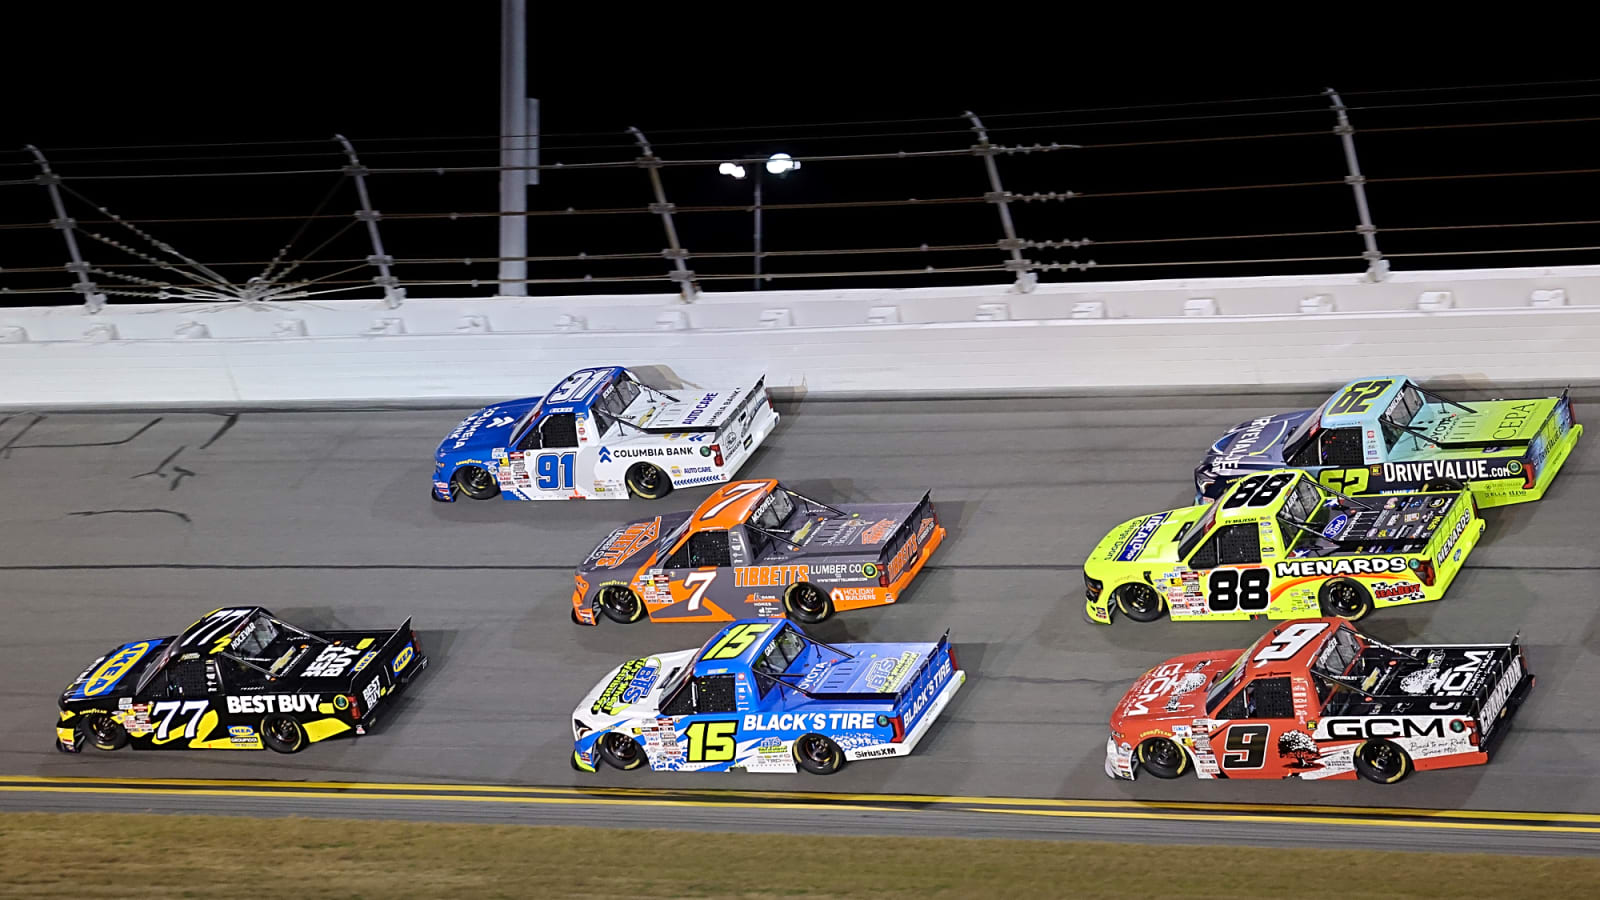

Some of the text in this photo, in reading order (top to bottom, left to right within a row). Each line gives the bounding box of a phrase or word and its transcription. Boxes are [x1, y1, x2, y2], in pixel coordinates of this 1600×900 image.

[547, 367, 616, 404] 91
[682, 392, 718, 425] AUTO CARE
[1493, 402, 1535, 439] CEPA
[614, 446, 694, 458] COLUMBIA BANK
[535, 452, 577, 491] 91
[700, 481, 768, 521] 7
[1222, 473, 1296, 510] 88
[1437, 508, 1470, 565] MENARDS
[684, 570, 718, 612] 7
[734, 565, 810, 588] TIBBETTS
[811, 564, 847, 574] LUMBER
[1208, 568, 1271, 612] 88
[1276, 559, 1407, 578] MENARDS
[180, 609, 253, 648] 77
[229, 621, 257, 650] HOCEVAR
[701, 623, 773, 661] 15
[1252, 621, 1330, 661] 9
[320, 646, 361, 677] BUY
[362, 674, 381, 700] BEST
[367, 687, 382, 709] BUY
[903, 684, 934, 729] BLACK'S
[932, 659, 951, 689] TIRE
[1479, 654, 1523, 736] CHAMPION
[152, 699, 210, 740] 77
[226, 695, 276, 714] BEST
[278, 693, 320, 713] BUY
[1327, 718, 1446, 739] GCM
[686, 720, 738, 762] 15
[743, 713, 826, 731] BLACK'S
[830, 713, 875, 730] TIRE
[854, 748, 897, 758] SiriusXM
[1222, 723, 1271, 770] 9
